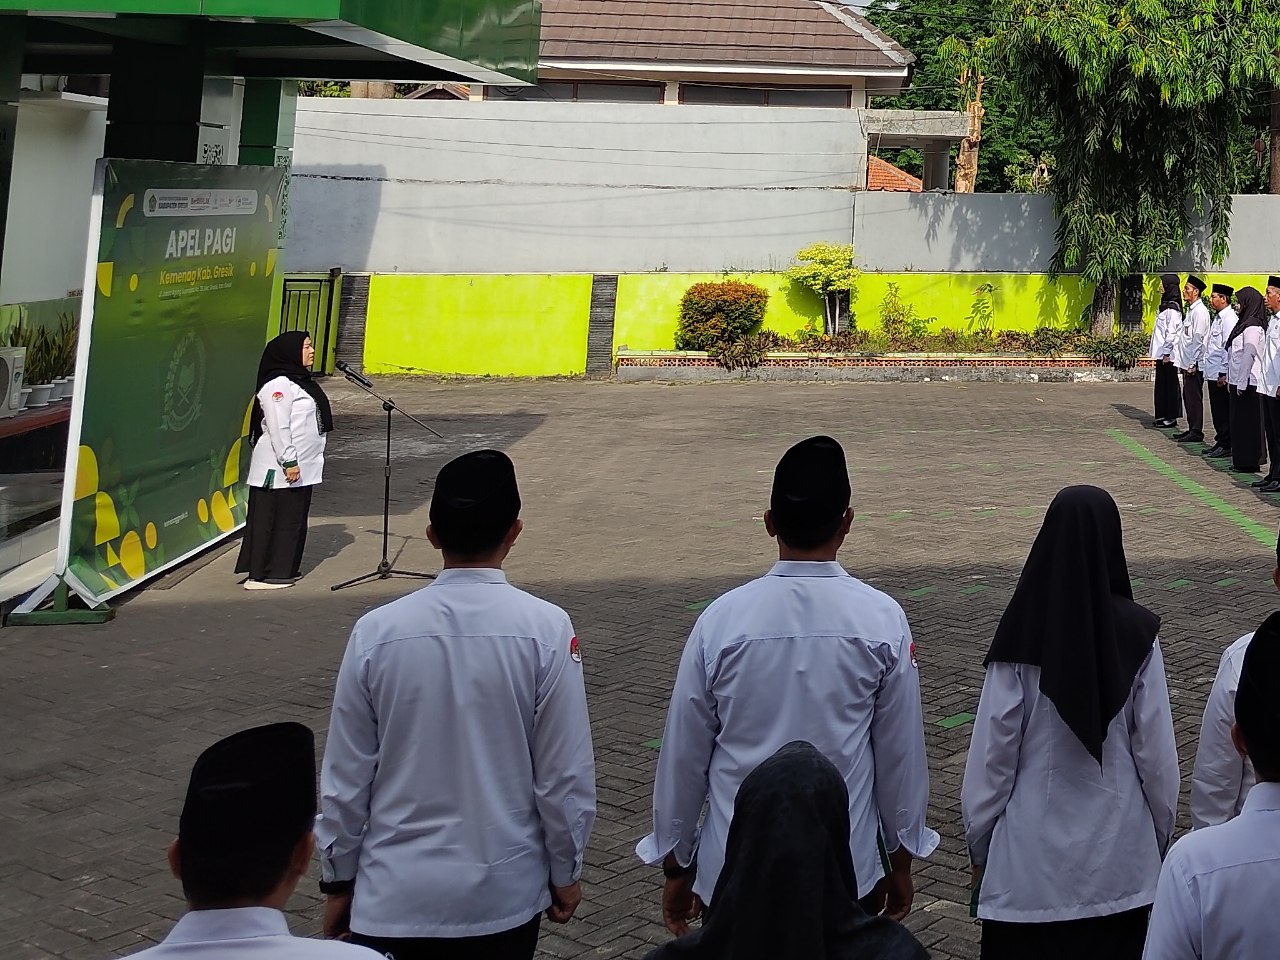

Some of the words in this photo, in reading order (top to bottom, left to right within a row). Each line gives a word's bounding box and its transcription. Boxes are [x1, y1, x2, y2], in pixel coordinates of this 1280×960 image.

[165, 229, 201, 258] APEL
[203, 227, 237, 255] PAGI
[159, 270, 196, 286] Kemenag
[196, 266, 212, 280] Kab.
[213, 263, 235, 278] Gresik
